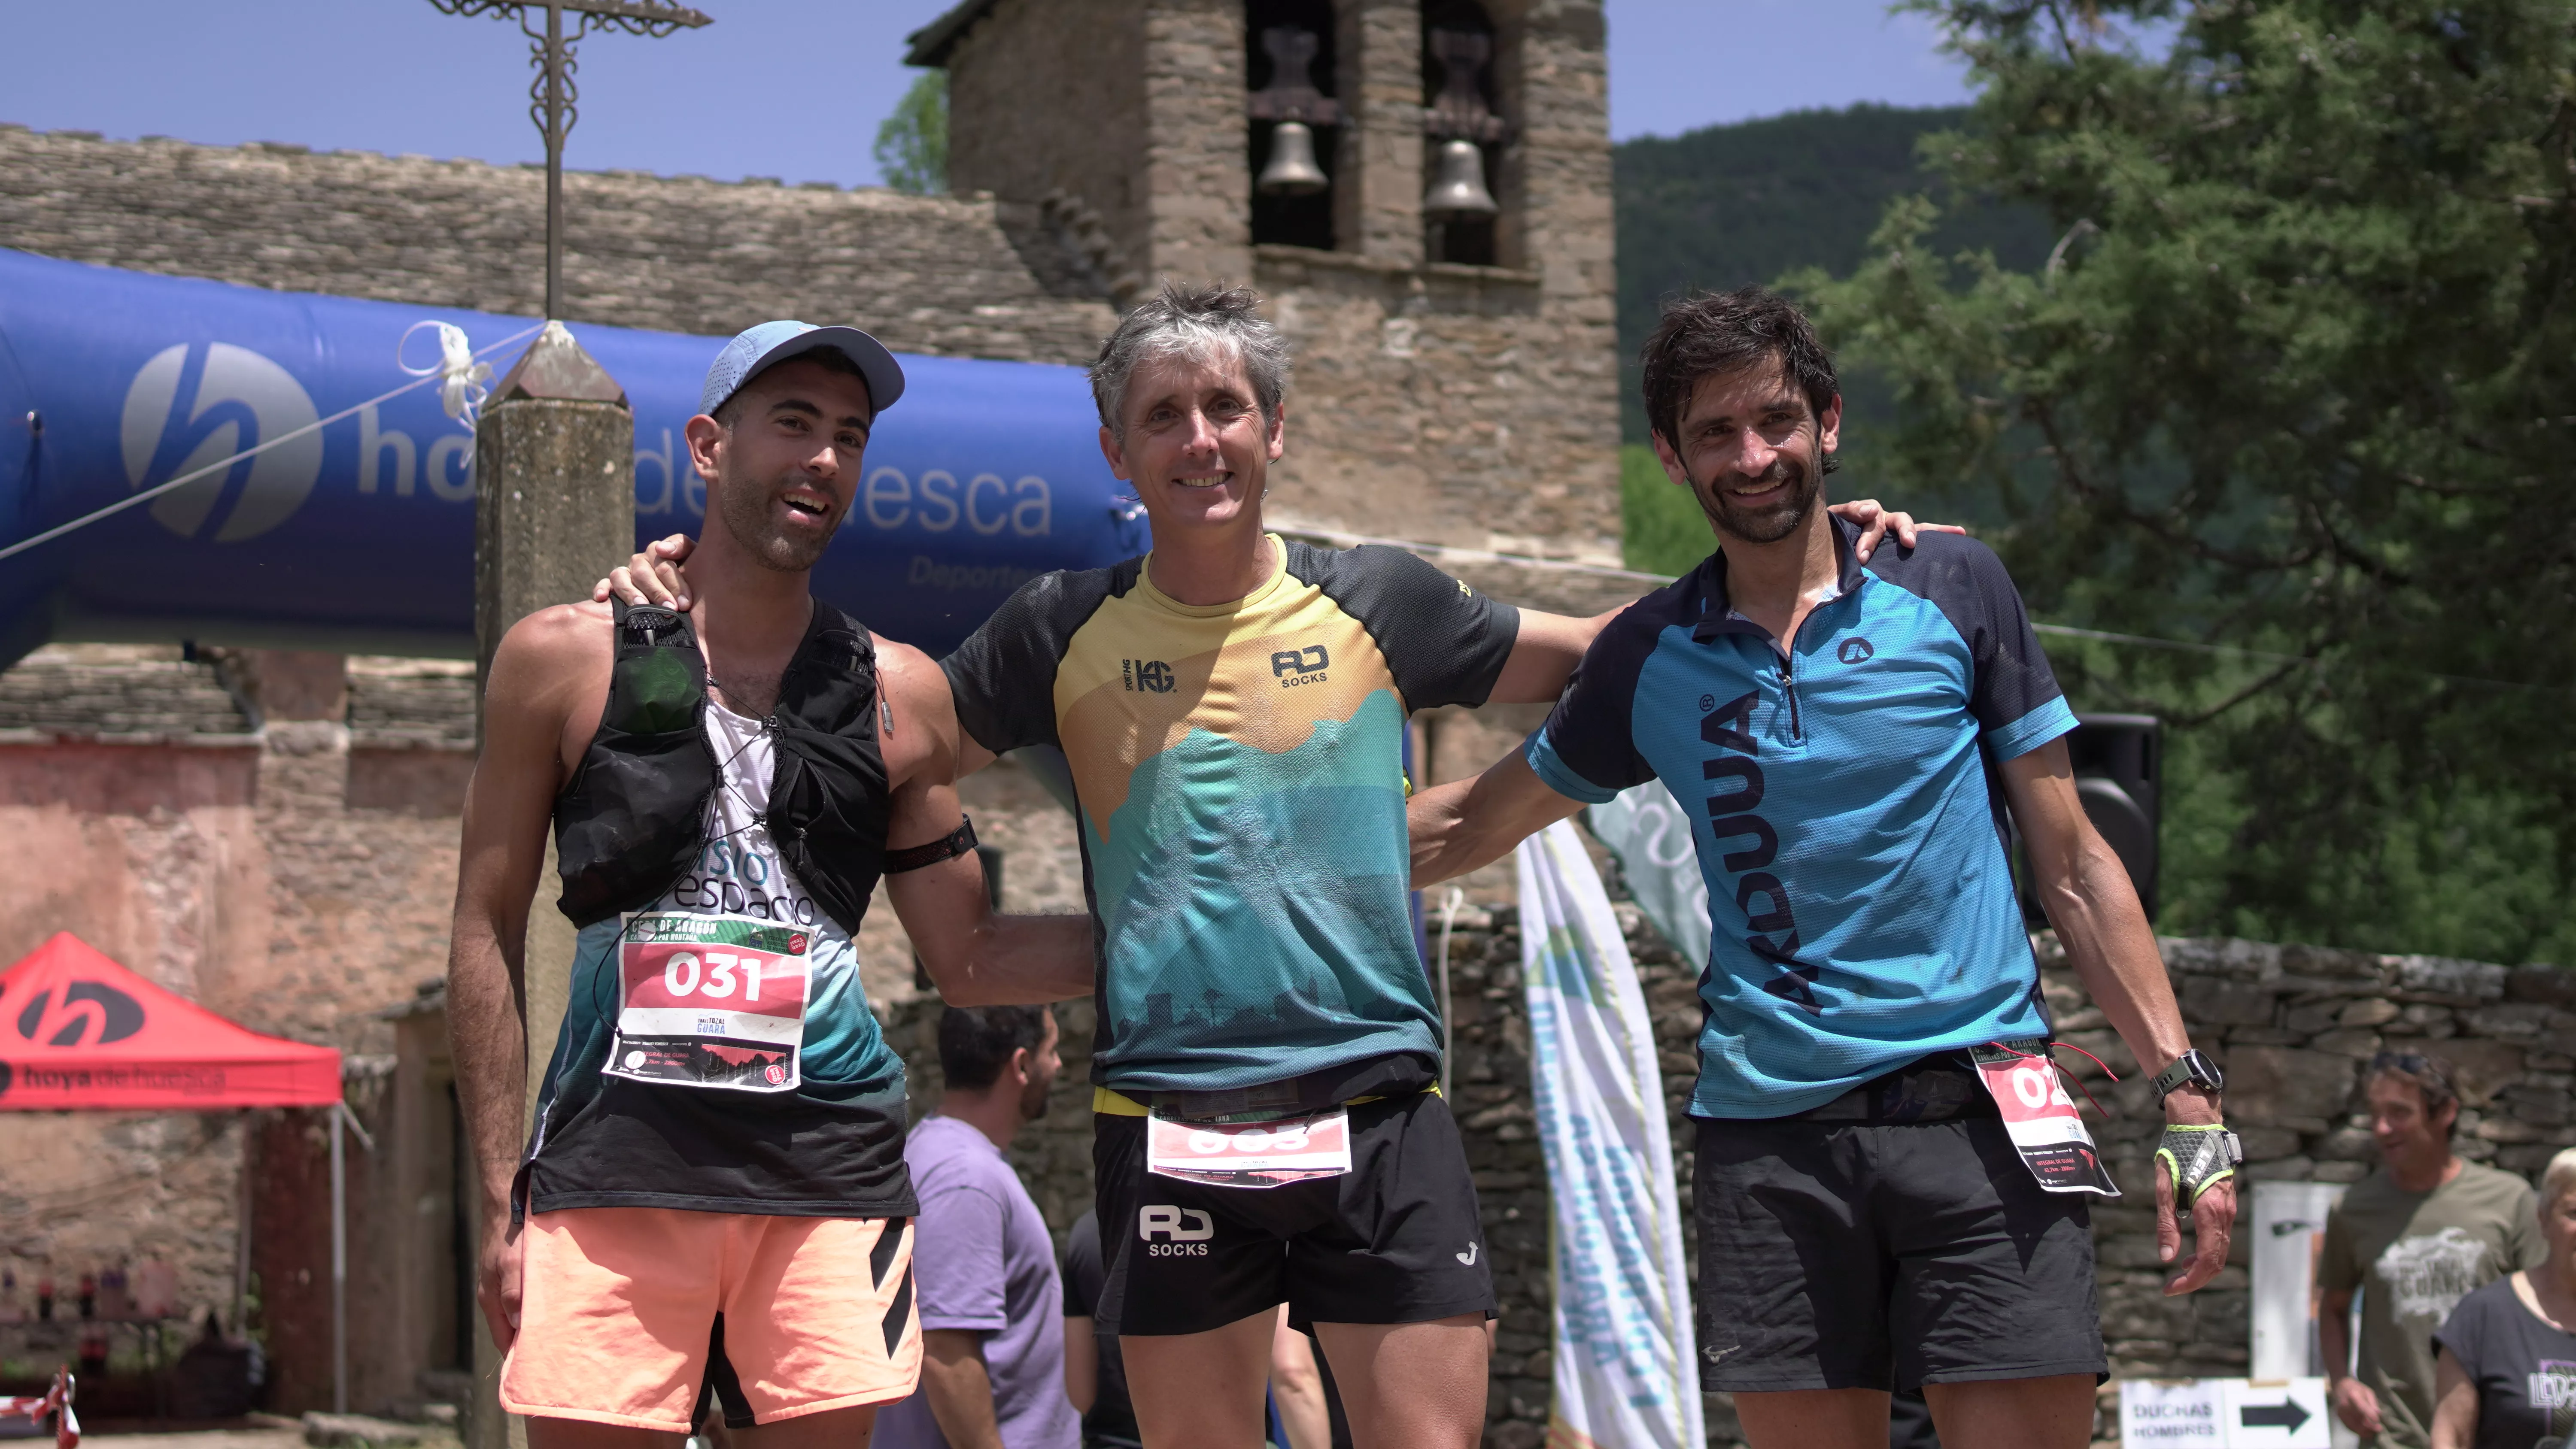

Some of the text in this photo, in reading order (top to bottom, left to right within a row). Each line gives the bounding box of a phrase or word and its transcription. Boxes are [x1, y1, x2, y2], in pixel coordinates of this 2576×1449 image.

[358, 403, 477, 502] ho
[844, 466, 1051, 536] esca
[1282, 672, 1327, 688] SOCKS
[674, 875, 815, 926] espacio
[660, 920, 671, 932] DE
[675, 920, 717, 934] ARAGÓN
[664, 952, 762, 1002] 031
[697, 1023, 725, 1034] GUARA
[2187, 1150, 2210, 1185] LEKI
[1149, 1243, 1209, 1257] SOCKS
[2133, 1401, 2213, 1418] DUCHAS
[2134, 1423, 2217, 1438] HOMBRES
